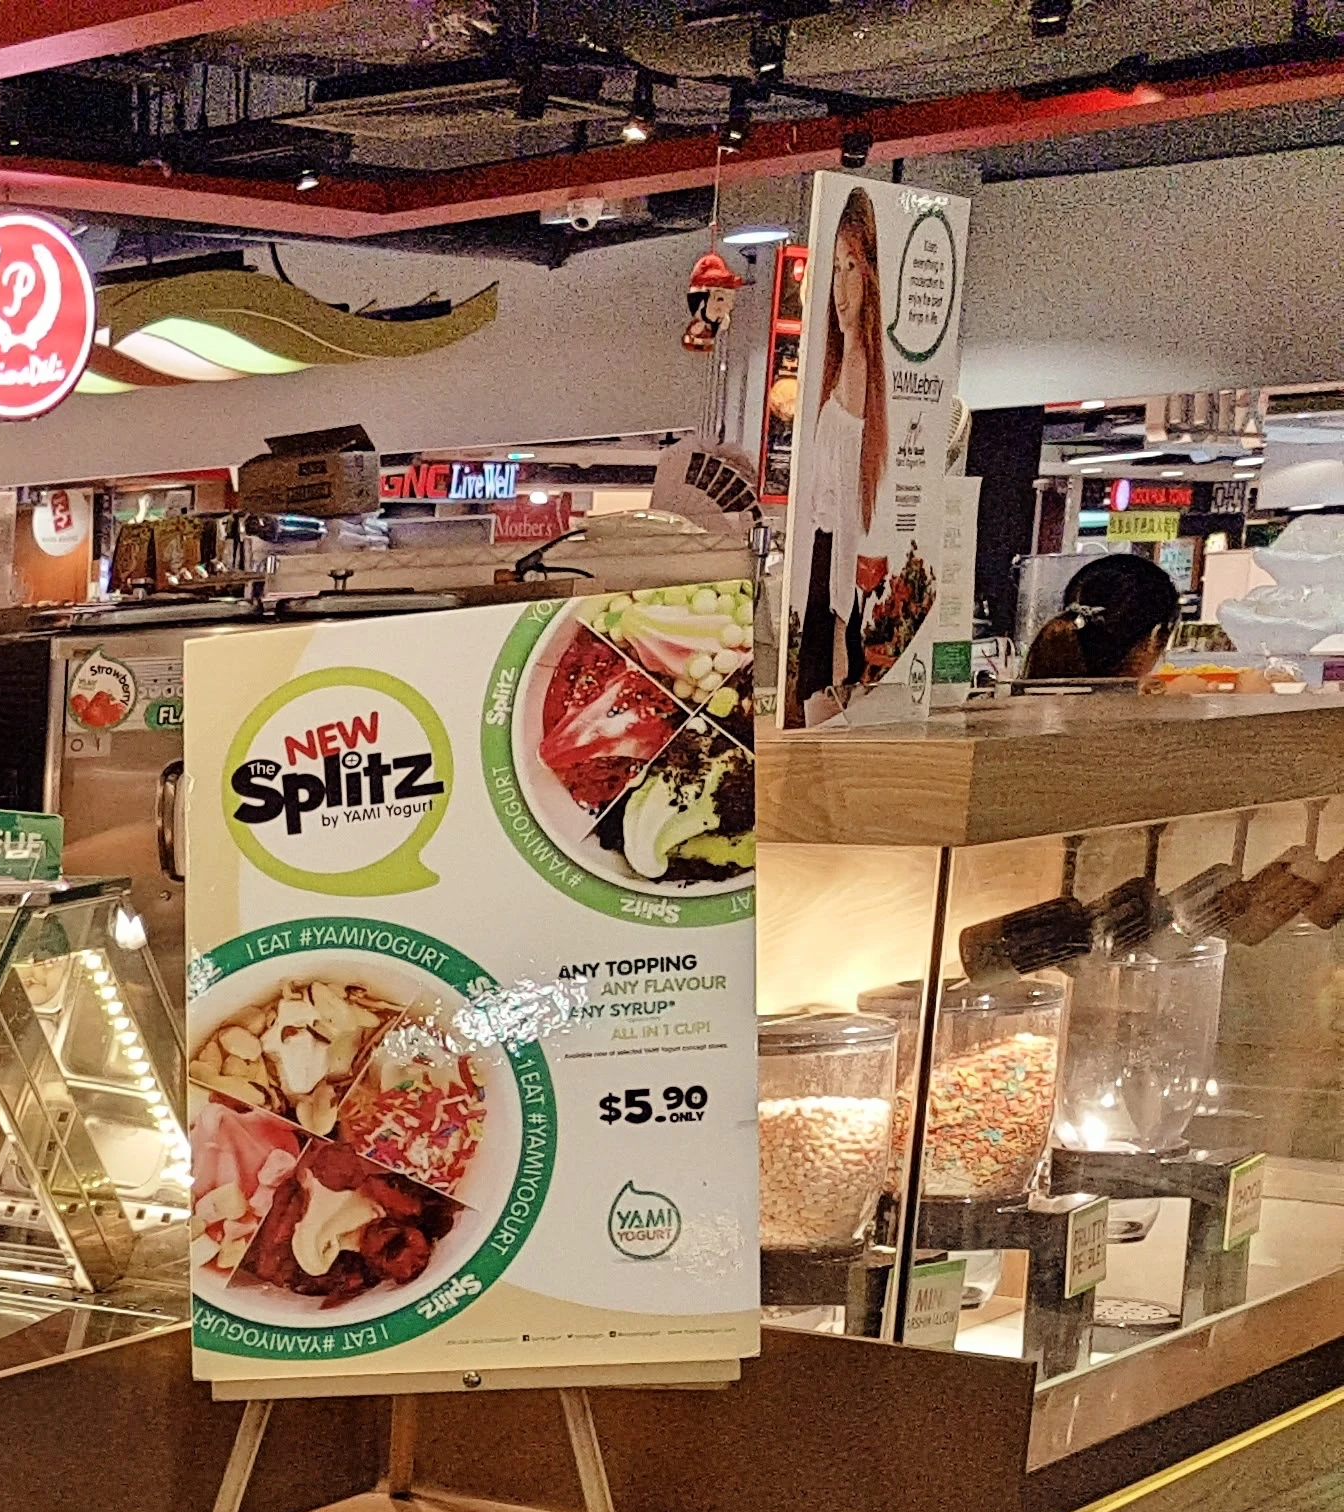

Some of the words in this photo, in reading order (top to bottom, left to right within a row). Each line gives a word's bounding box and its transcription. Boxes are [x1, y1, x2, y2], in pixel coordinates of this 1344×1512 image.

[380, 464, 451, 499] GNC
[485, 666, 517, 726] Splitz
[284, 711, 381, 767] NEW
[248, 760, 277, 777] The
[230, 749, 445, 836] Splitz
[321, 811, 339, 829] by
[344, 808, 382, 825] YAMI
[386, 799, 434, 824] Yogurt
[620, 897, 682, 924] Splitz
[258, 930, 293, 956] EAT
[299, 926, 450, 971] #YAMIYOGURT
[558, 962, 600, 980] ANY
[605, 954, 698, 977] TOPPING
[600, 980, 640, 996] ANY
[644, 975, 727, 993] FLAVOUR
[611, 1027, 638, 1041] ALL
[642, 1025, 659, 1038] IN
[519, 1068, 541, 1107] EAT
[599, 1085, 708, 1125] $5.90
[669, 1111, 705, 1123] ONLY
[492, 1113, 546, 1258] #YAMIYOGURT
[616, 1208, 672, 1230] YAMI
[616, 1229, 672, 1242] YOGURT
[416, 1272, 483, 1320] Splitz
[342, 1326, 378, 1351] EAT
